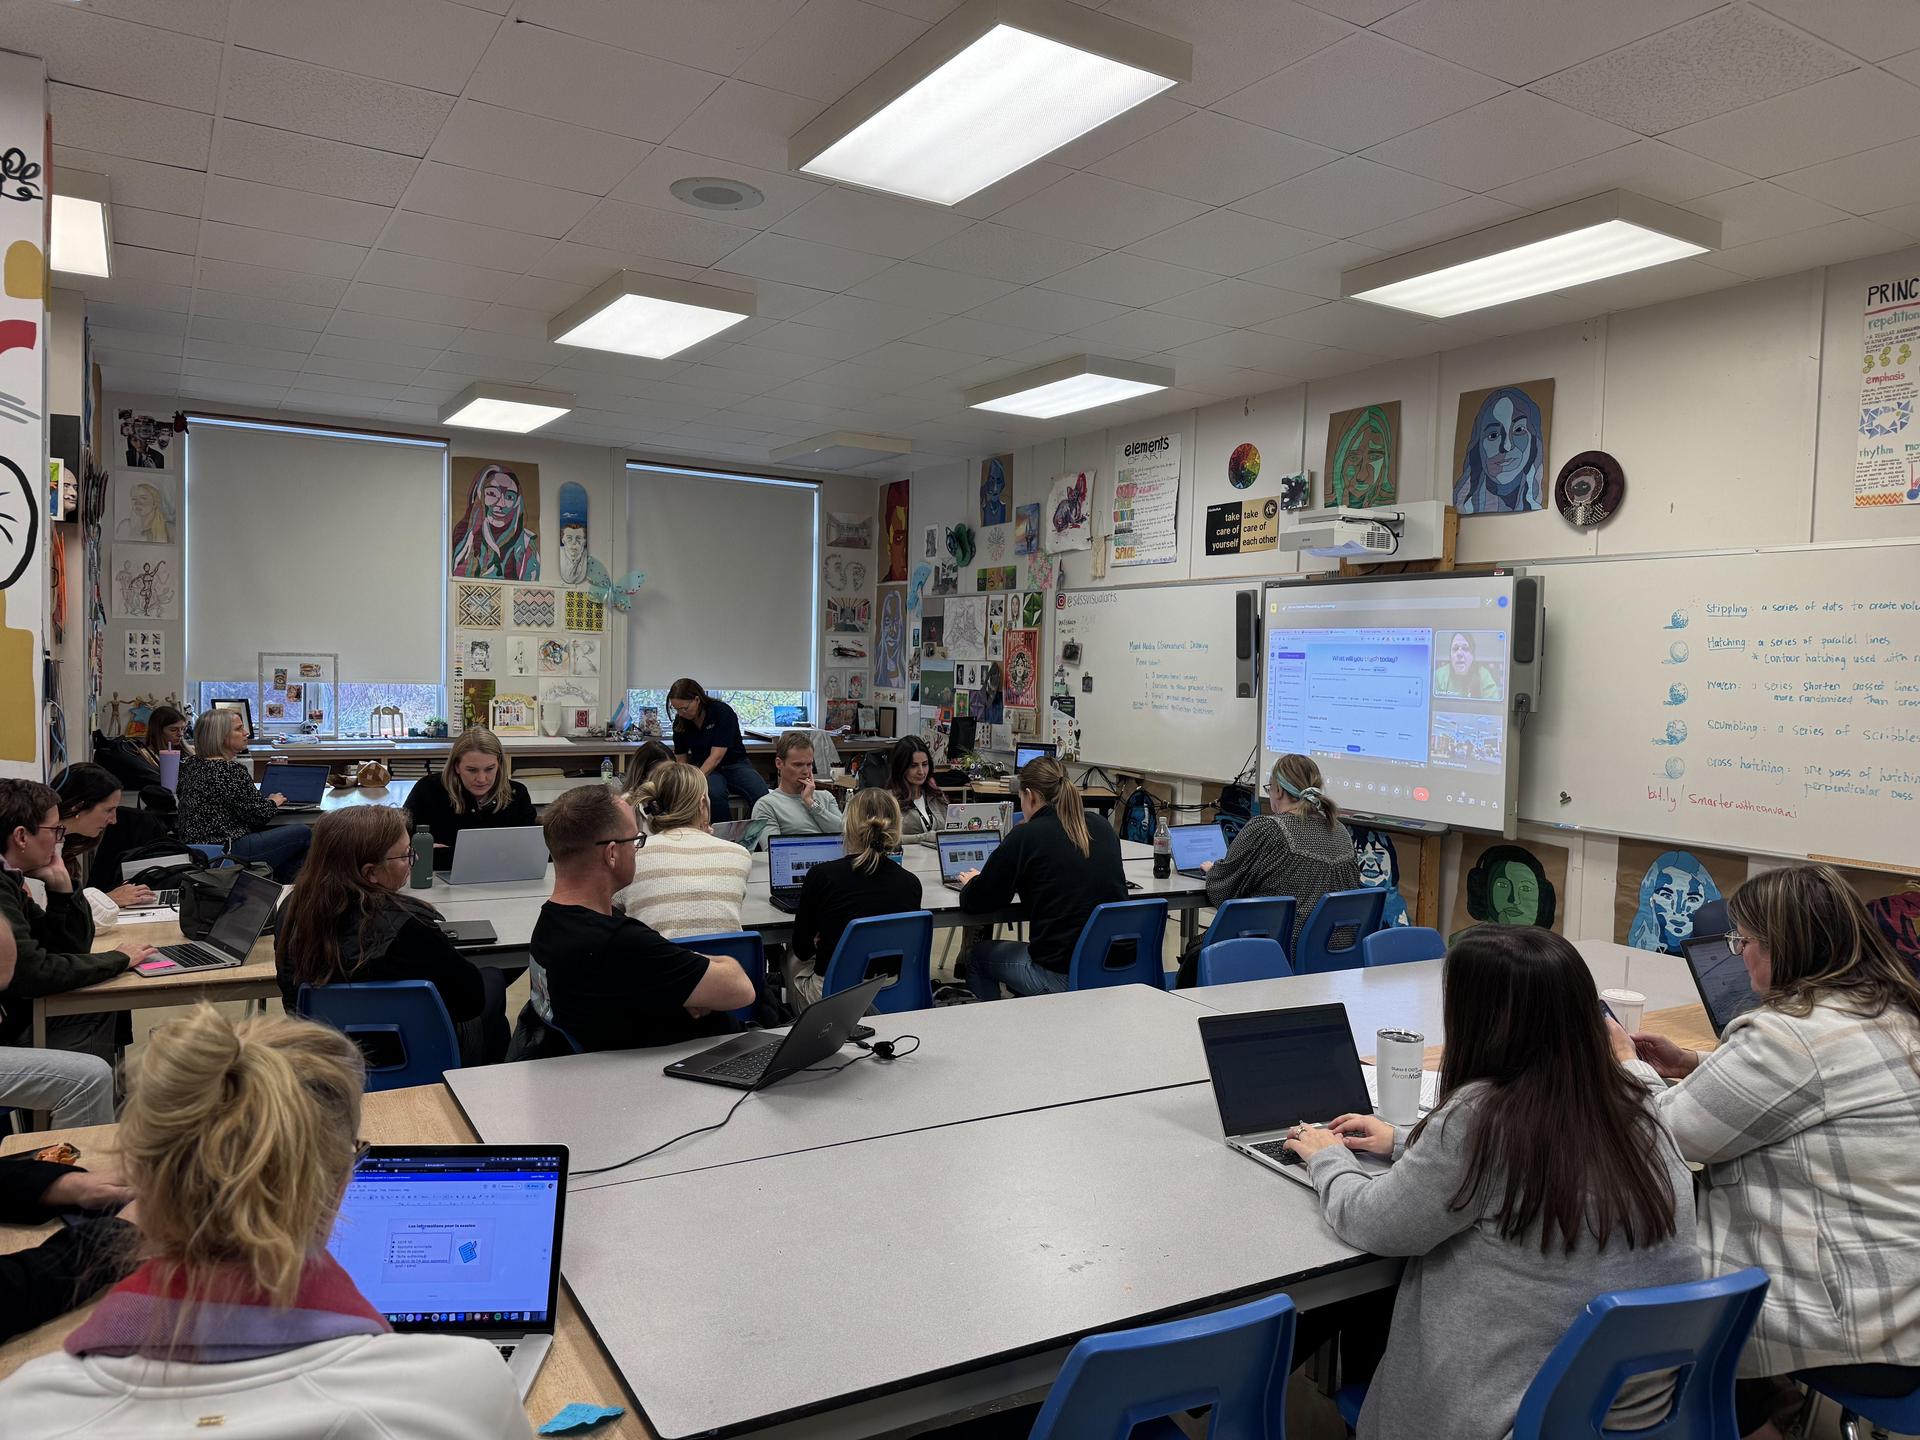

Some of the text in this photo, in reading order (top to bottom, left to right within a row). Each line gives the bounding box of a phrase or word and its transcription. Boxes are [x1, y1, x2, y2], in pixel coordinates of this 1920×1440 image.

[1868, 311, 1920, 331] repetition
[1865, 371, 1905, 386] emphasis
[1124, 436, 1170, 457] elements
[1859, 444, 1894, 459] rhythm
[1224, 511, 1241, 522] take
[1243, 509, 1259, 520] take
[1216, 524, 1240, 536] care of
[1242, 521, 1267, 533] care of
[1211, 538, 1240, 552] yourself
[1242, 534, 1277, 546] each other
[1772, 603, 1799, 612] series
[1804, 600, 1816, 611] of
[1822, 601, 1844, 612] dots
[1850, 600, 1864, 611] to
[1869, 601, 1897, 611] create
[1757, 639, 1765, 647] a
[1770, 638, 1797, 648] series
[1803, 636, 1813, 645] of
[1821, 632, 1857, 650] parallel
[1864, 632, 1891, 646] lines
[1804, 652, 1847, 671] hatching
[1853, 653, 1877, 663] used
[1835, 723, 1850, 736] of
[1858, 766, 1872, 779] of
